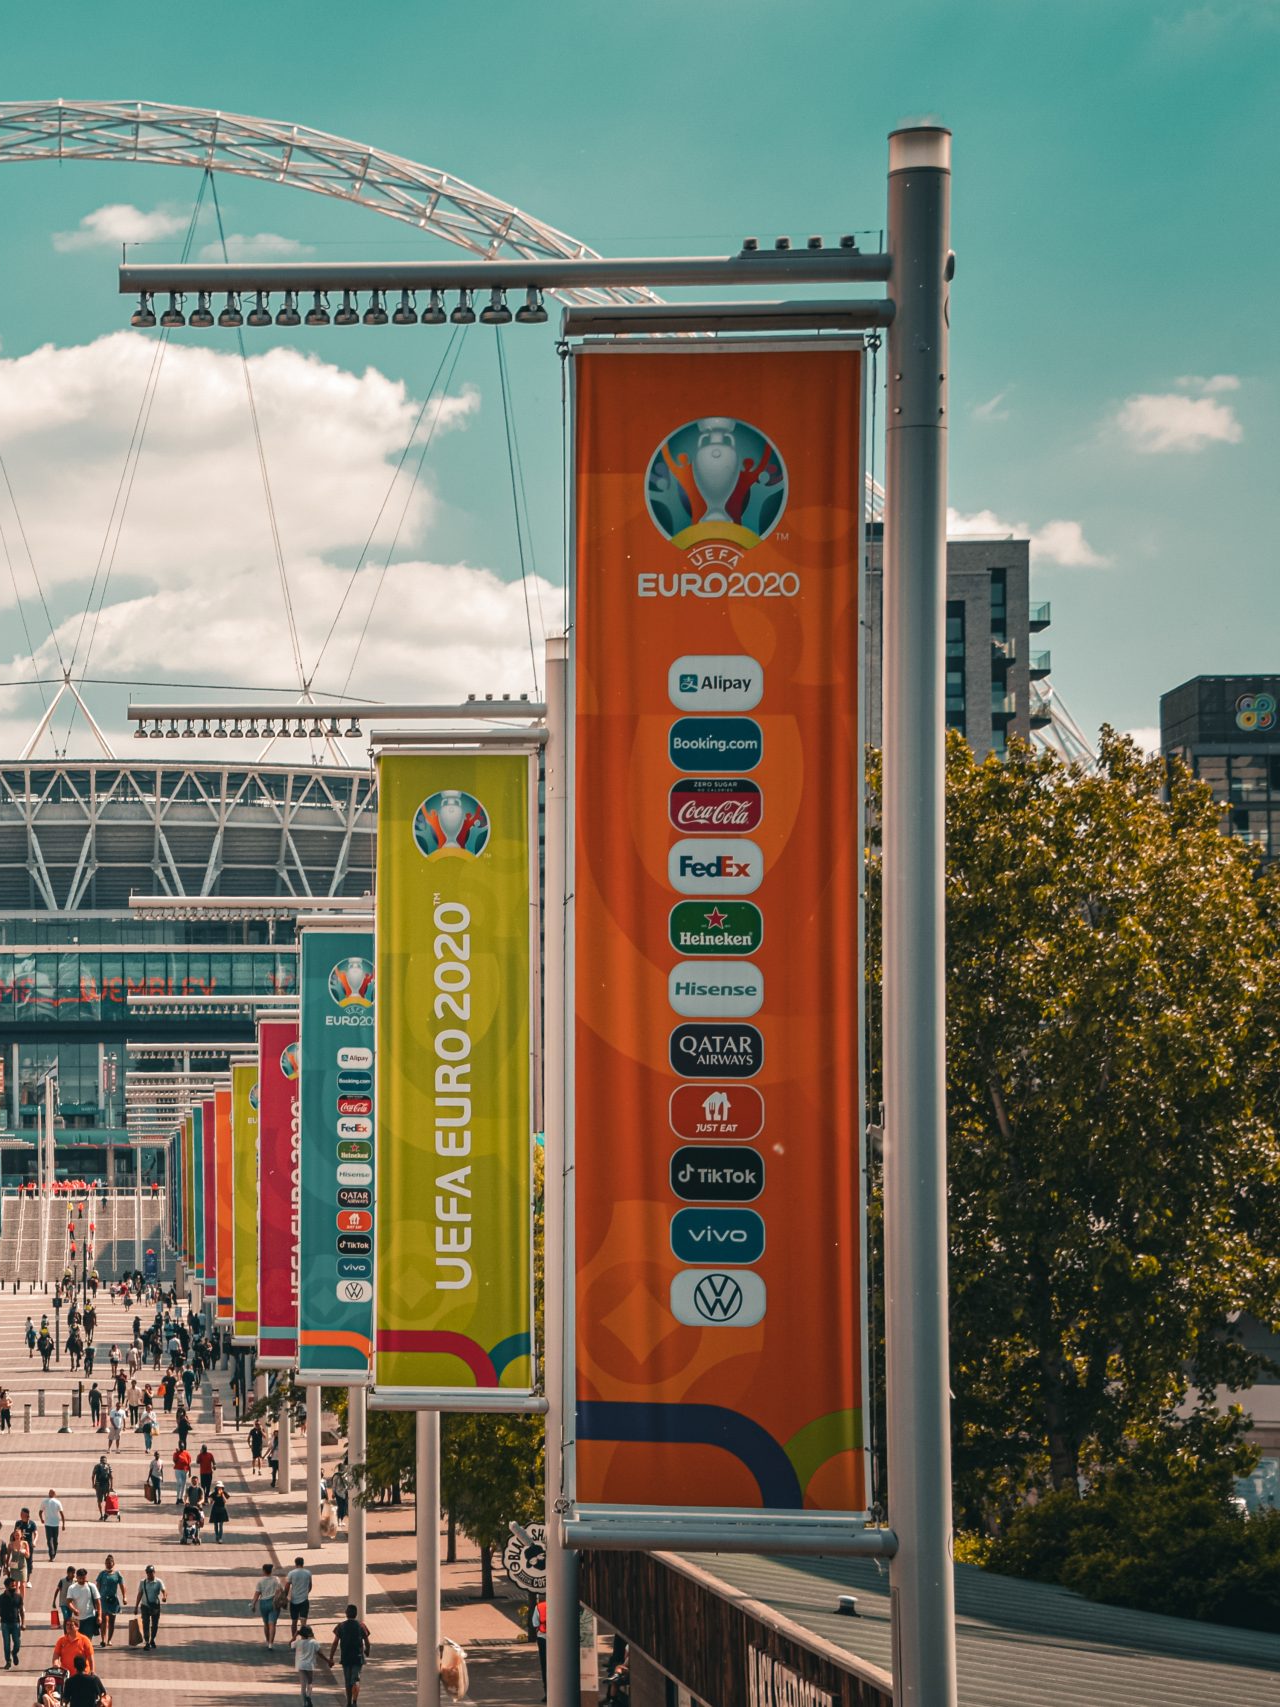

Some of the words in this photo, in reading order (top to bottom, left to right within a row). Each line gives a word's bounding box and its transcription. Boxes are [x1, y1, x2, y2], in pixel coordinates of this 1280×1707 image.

[690, 548, 741, 568] UEFA
[637, 572, 800, 598] EURO2020
[701, 675, 752, 693] Alipay
[673, 737, 758, 752] Booking.com
[677, 800, 753, 825] Coca-Cola
[679, 855, 751, 878] FedEx
[679, 931, 753, 946] Heineken
[674, 981, 757, 996] Hisense
[325, 1015, 375, 1027] EURO20
[679, 1035, 753, 1056] QATAR
[696, 1054, 754, 1066] AIRWAYS
[434, 1029, 472, 1157] EURO
[340, 1102, 368, 1113] Coca-Cola
[341, 1123, 368, 1133] FedEx
[695, 1123, 718, 1133] JUST
[719, 1124, 739, 1133] EAT
[697, 1168, 757, 1184] TikTok
[340, 1191, 368, 1200] QATAR
[434, 1165, 472, 1290] UEFA
[688, 1225, 748, 1242] vivo
[343, 1263, 366, 1271] vivo
